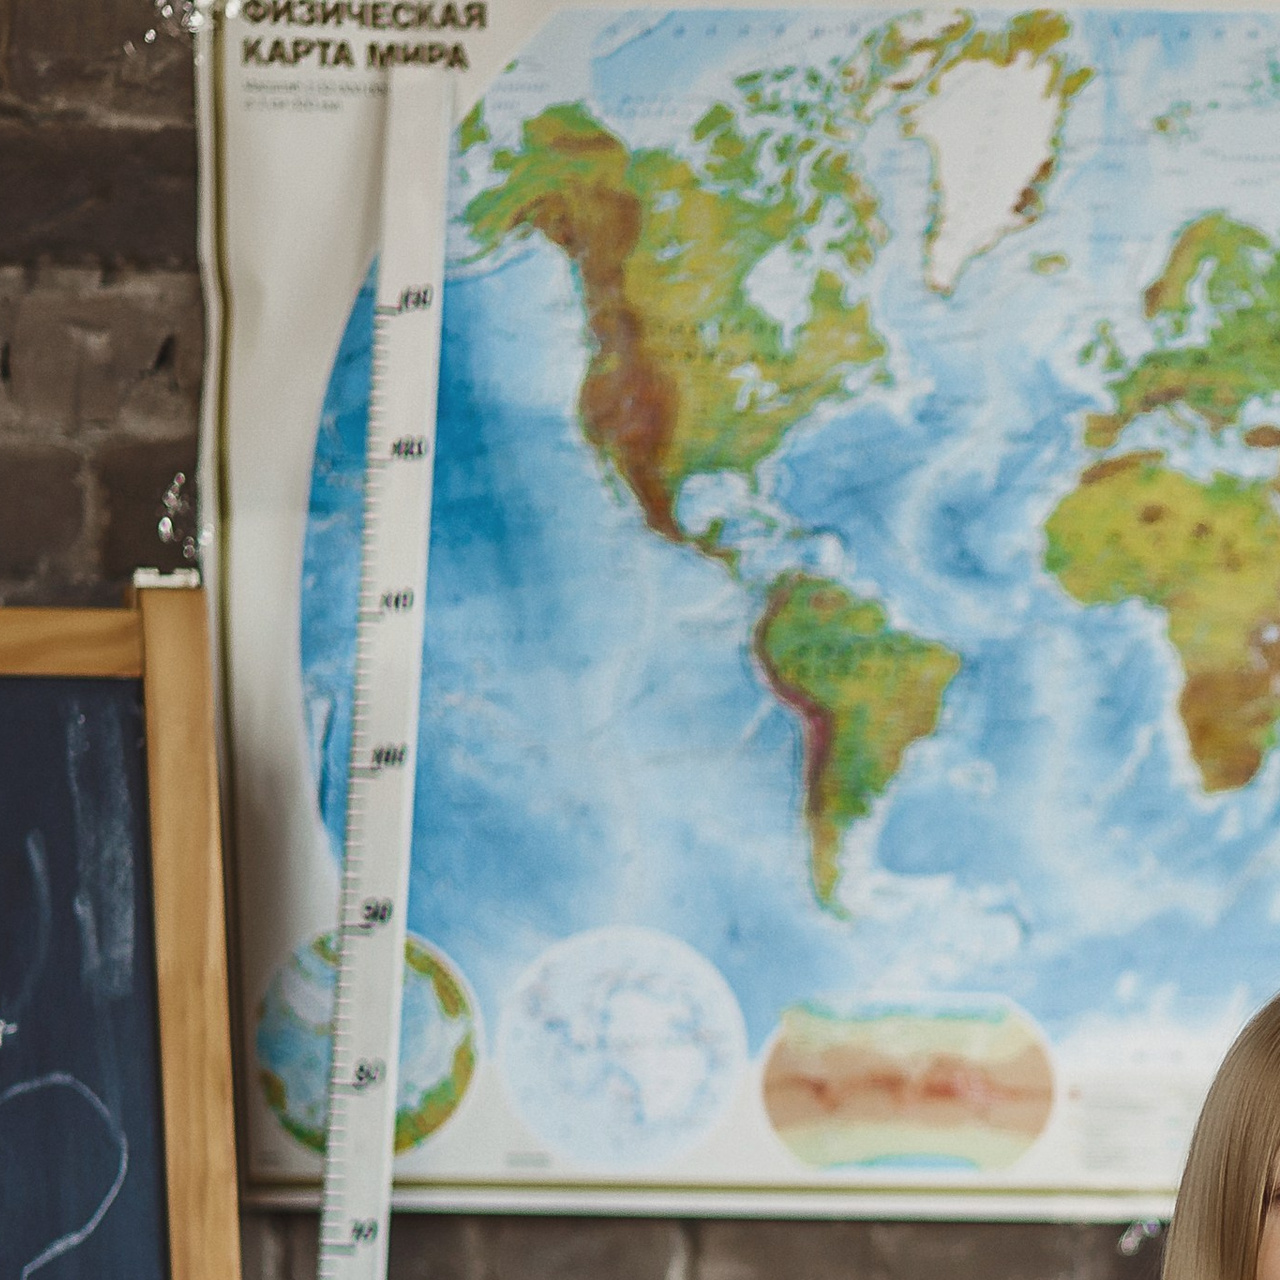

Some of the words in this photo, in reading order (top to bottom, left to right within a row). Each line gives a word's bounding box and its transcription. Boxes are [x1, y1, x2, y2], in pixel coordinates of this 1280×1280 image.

[242, 1, 487, 29] ФИЗИЧЕСКАЯ
[242, 37, 354, 67] КАРТА
[366, 42, 470, 70] МИРА
